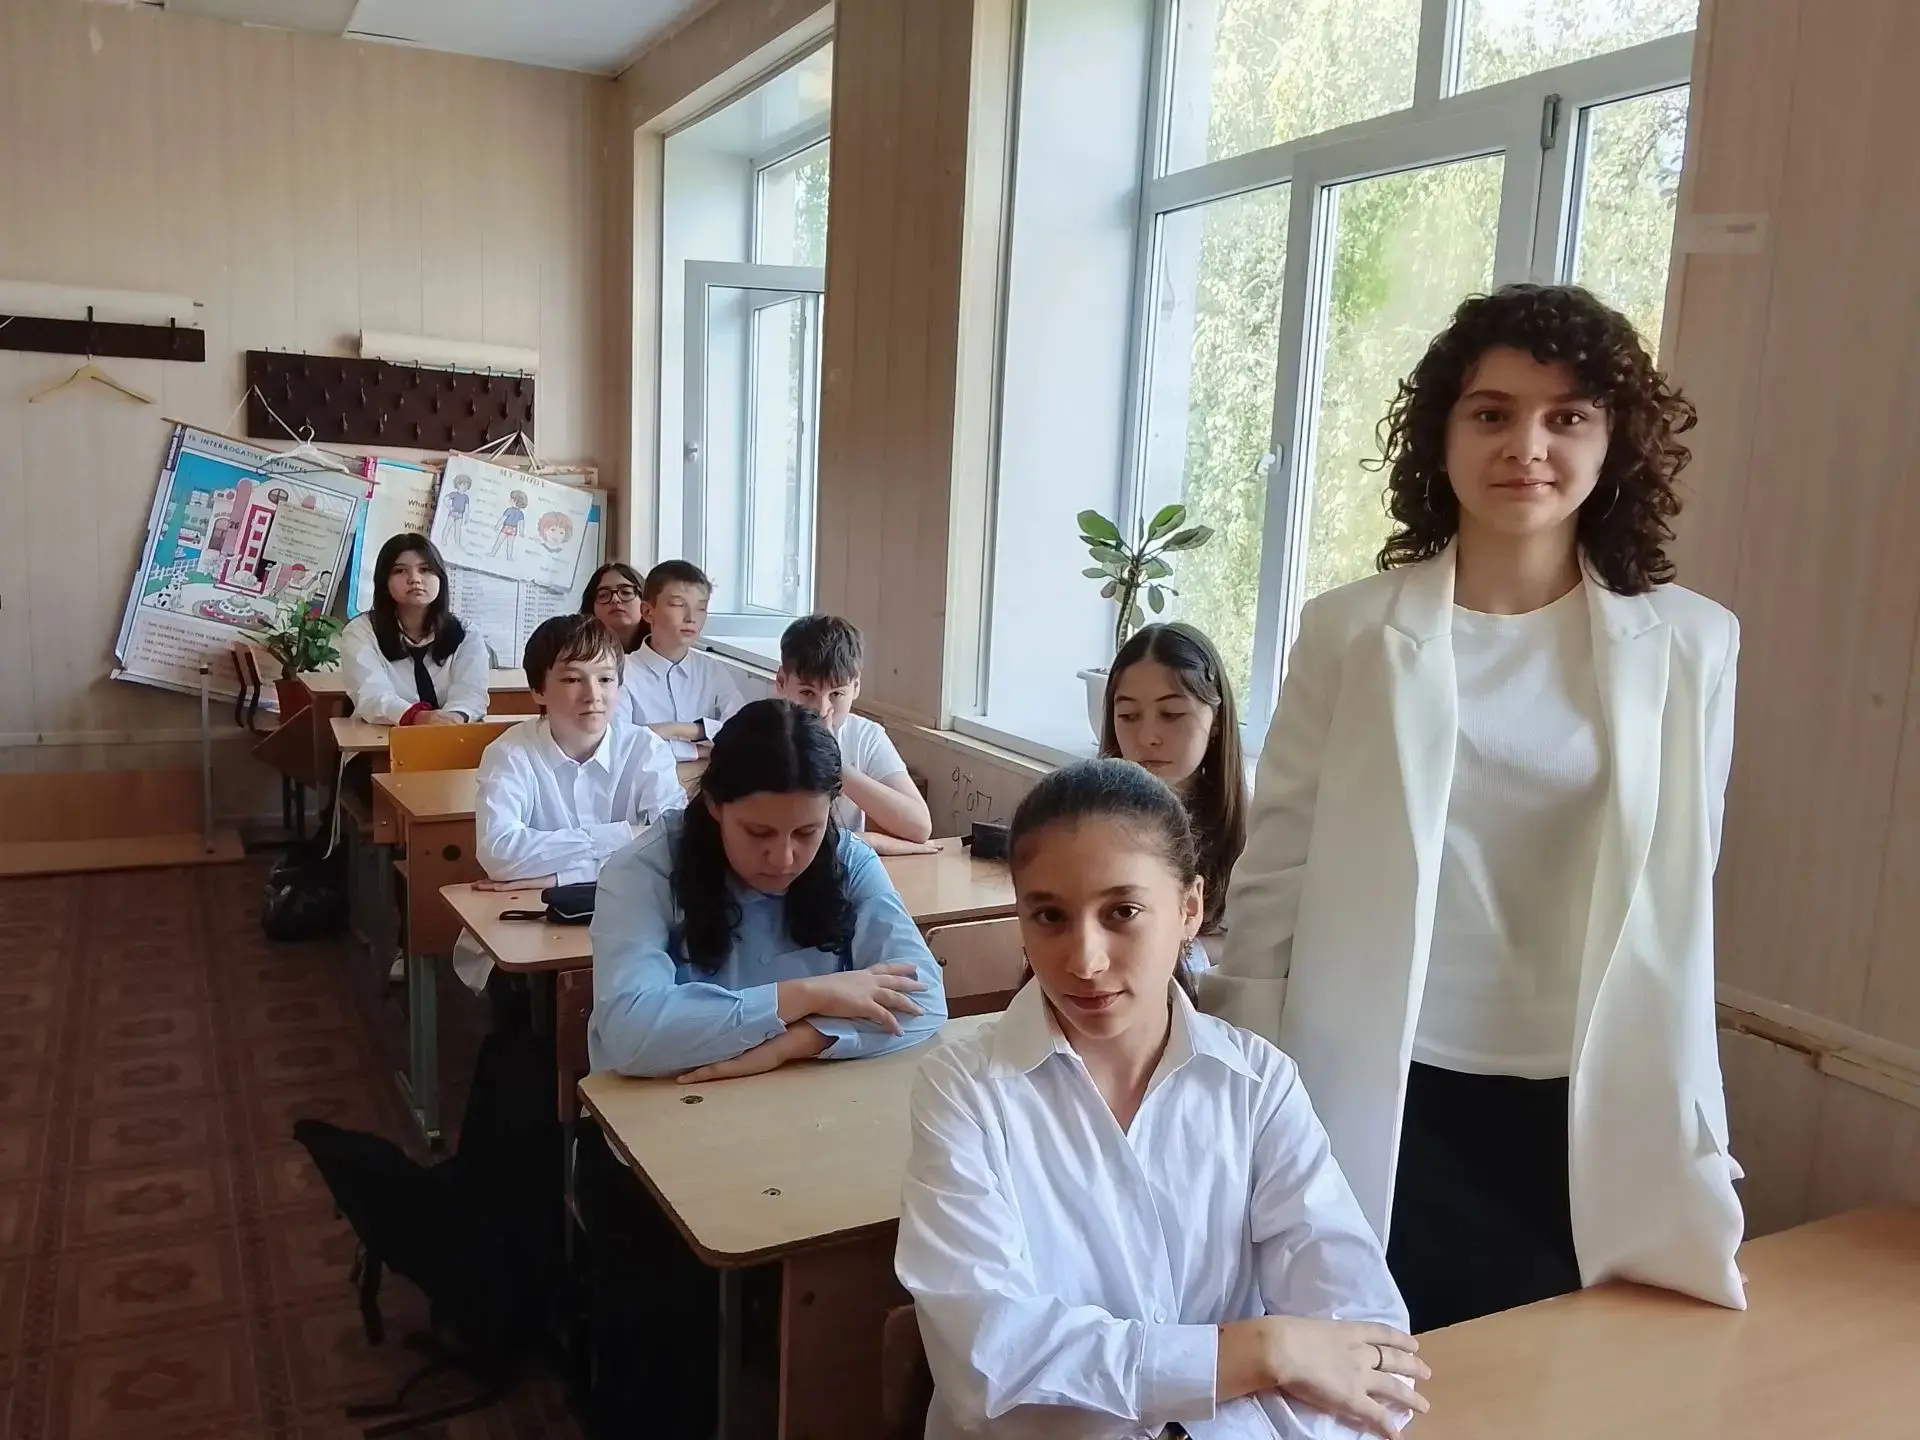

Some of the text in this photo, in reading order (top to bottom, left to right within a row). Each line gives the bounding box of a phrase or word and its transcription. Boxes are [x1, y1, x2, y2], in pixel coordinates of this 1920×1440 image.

[200, 438, 264, 461] INTERROGATIVE
[266, 457, 308, 474] ENTENCES
[408, 497, 428, 509] What
[229, 520, 240, 530] 26
[404, 520, 424, 531] What
